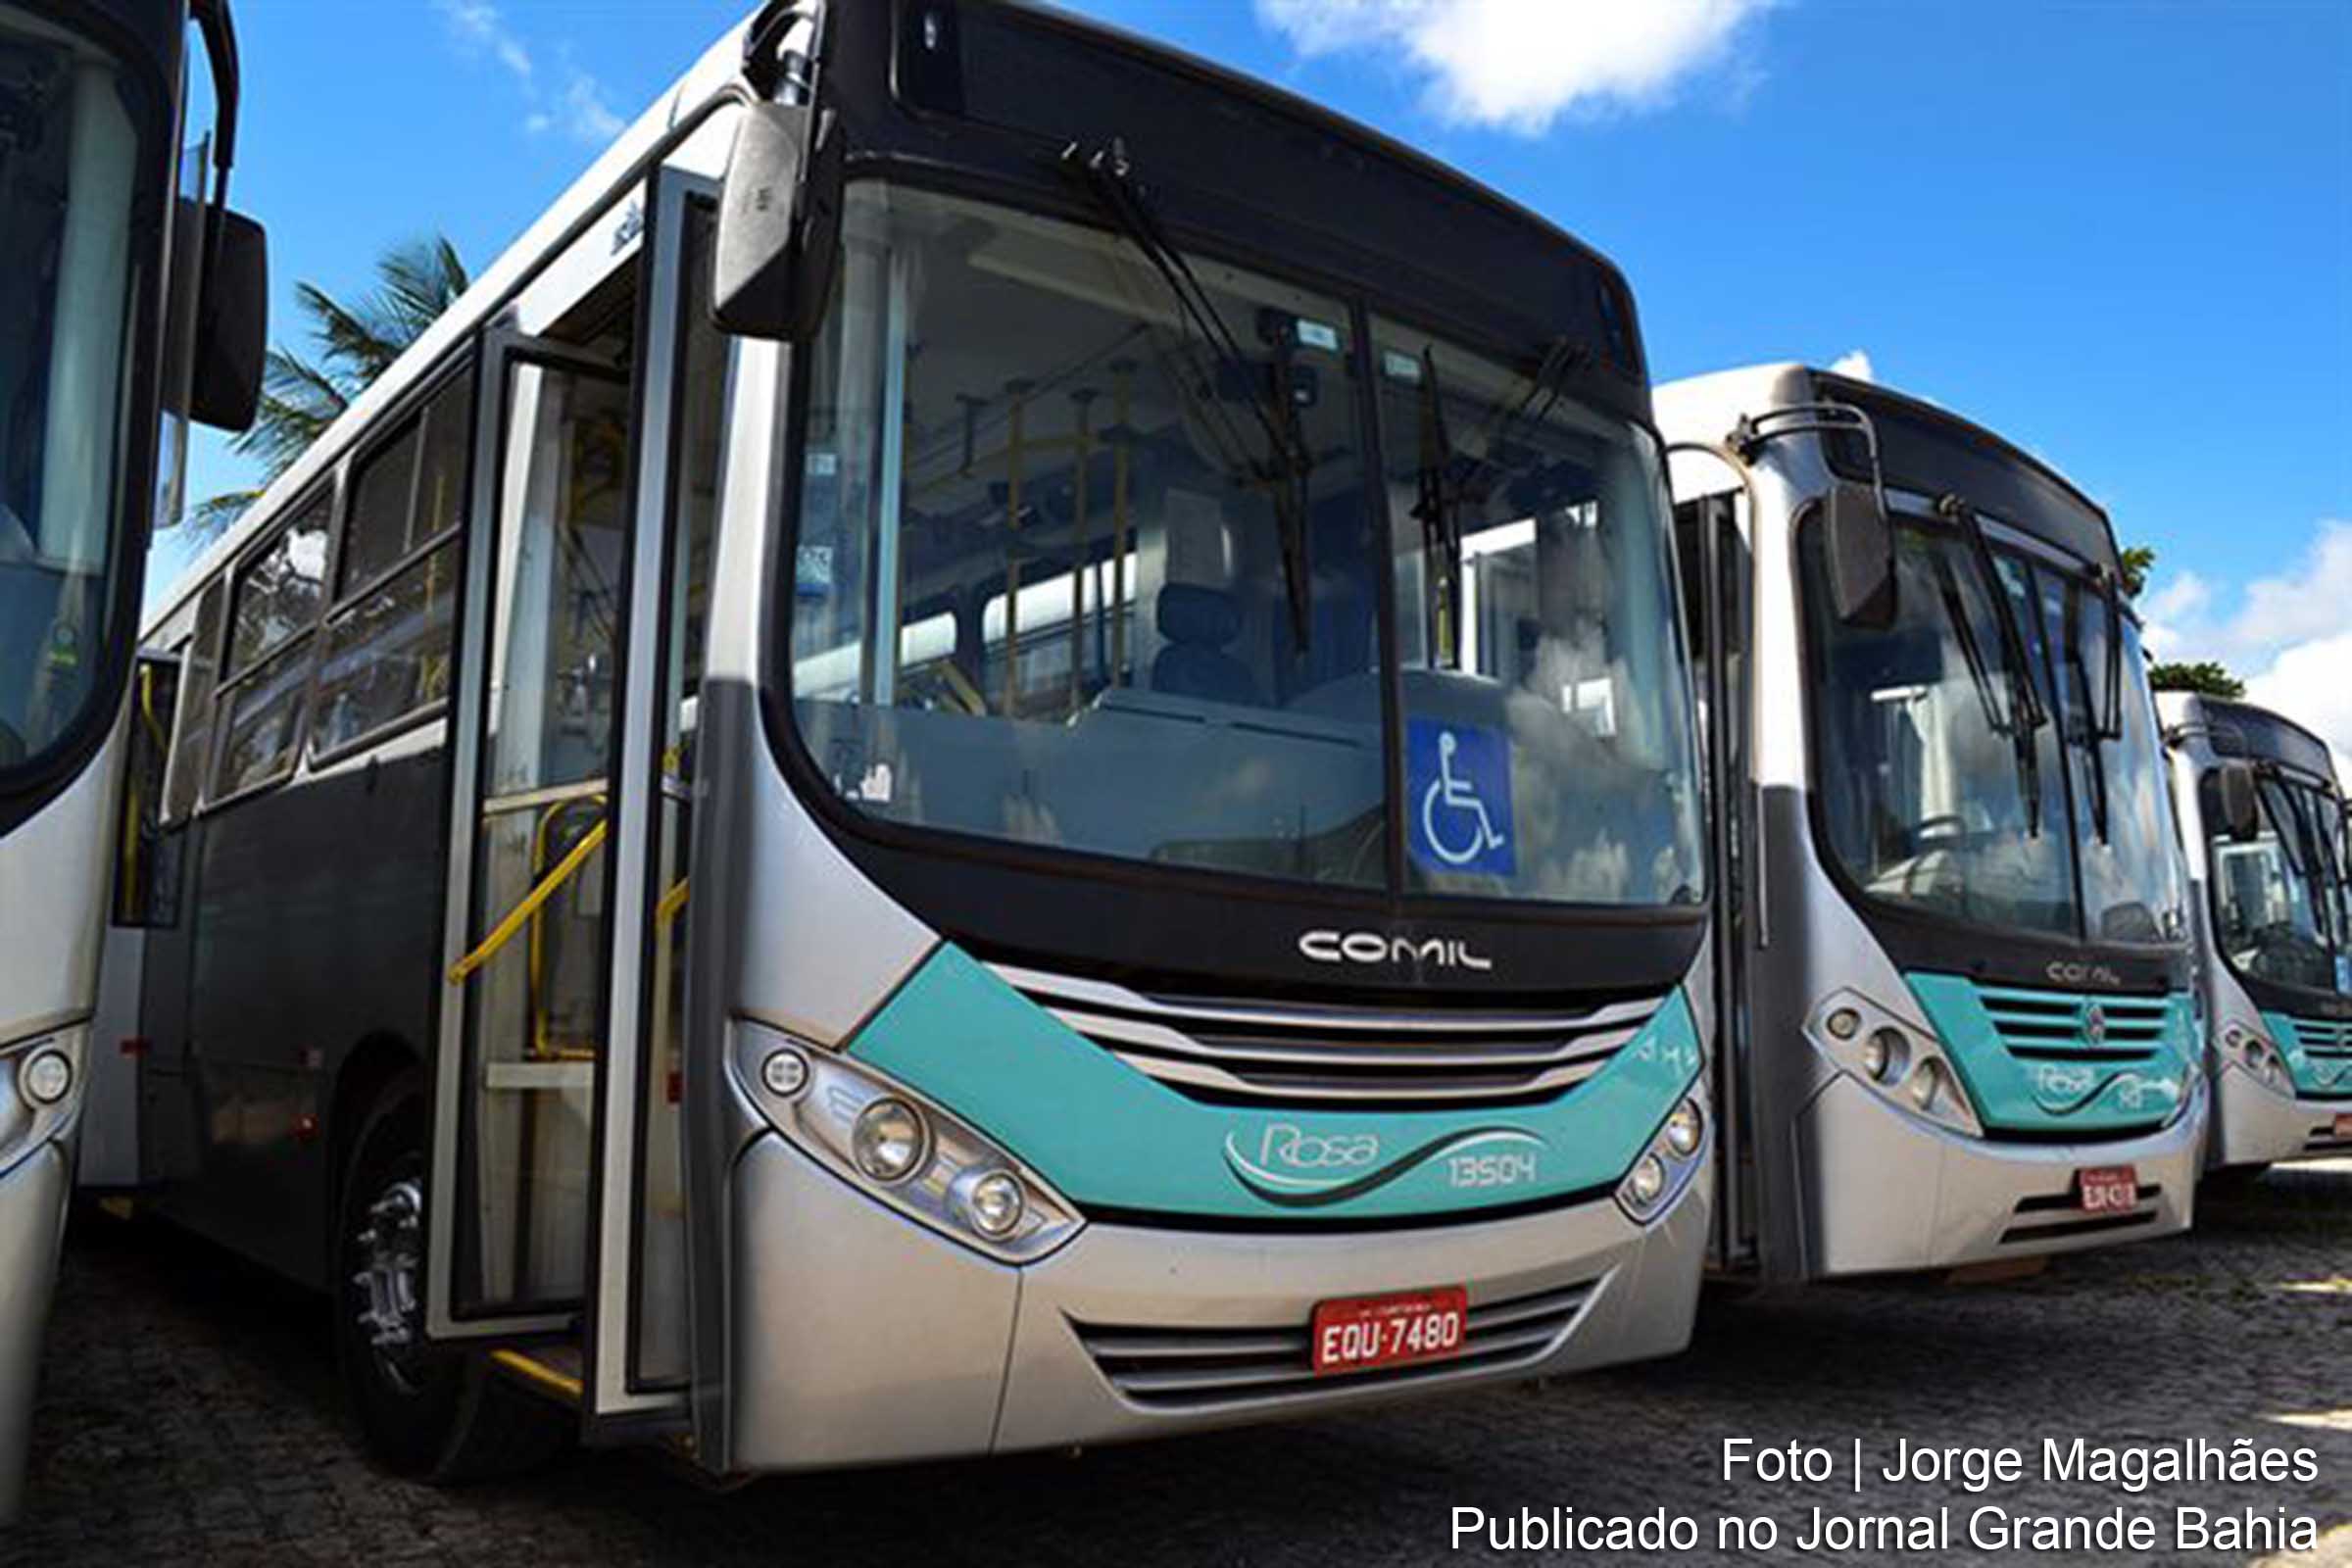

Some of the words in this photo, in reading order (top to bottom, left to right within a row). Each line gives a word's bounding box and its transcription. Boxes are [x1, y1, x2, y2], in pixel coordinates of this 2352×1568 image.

[1298, 930, 1492, 969] COMIL
[1259, 1123, 1379, 1167] Rosa
[1448, 1154, 1537, 1188] 13504
